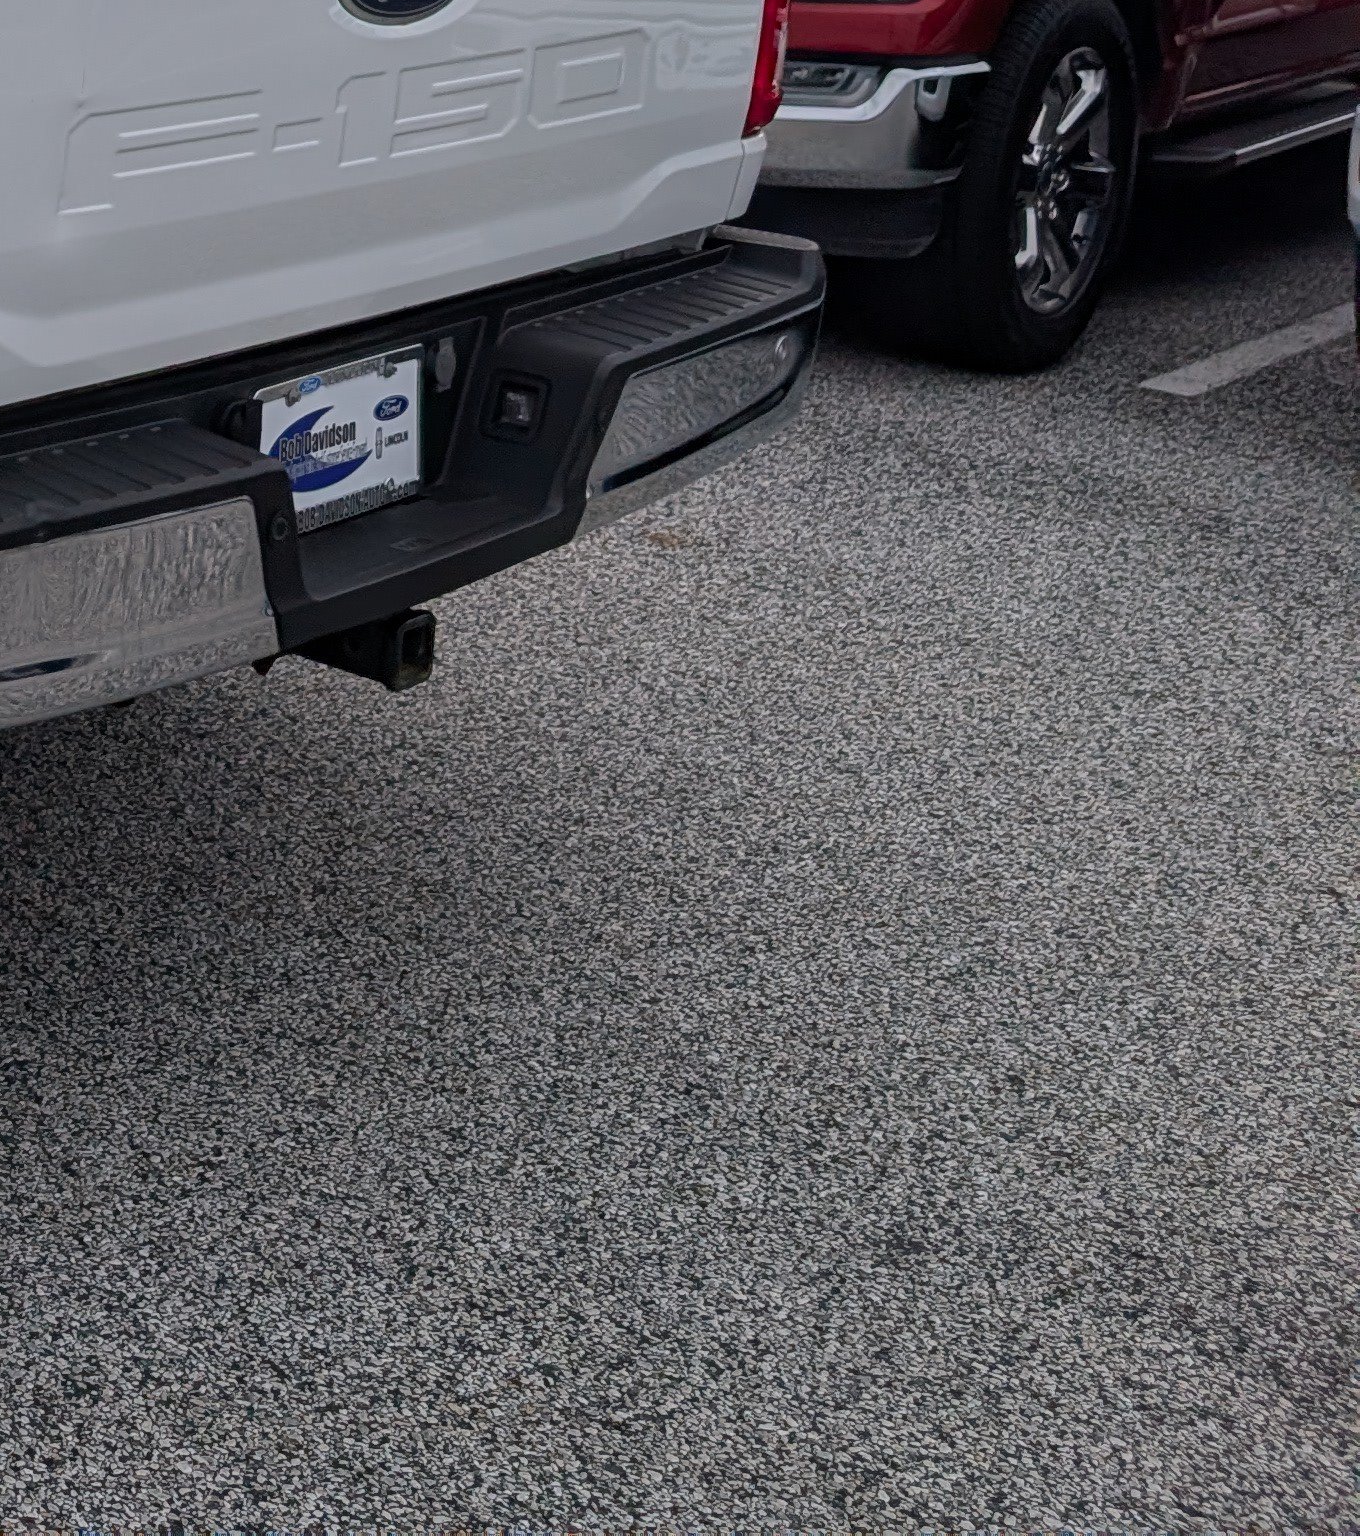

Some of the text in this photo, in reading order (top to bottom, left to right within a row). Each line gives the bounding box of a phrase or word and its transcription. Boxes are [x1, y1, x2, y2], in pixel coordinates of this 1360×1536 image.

[58, 27, 650, 216] F-150
[281, 434, 302, 462] Bob
[304, 421, 357, 455] Davidson
[384, 430, 409, 448] LINCOLN
